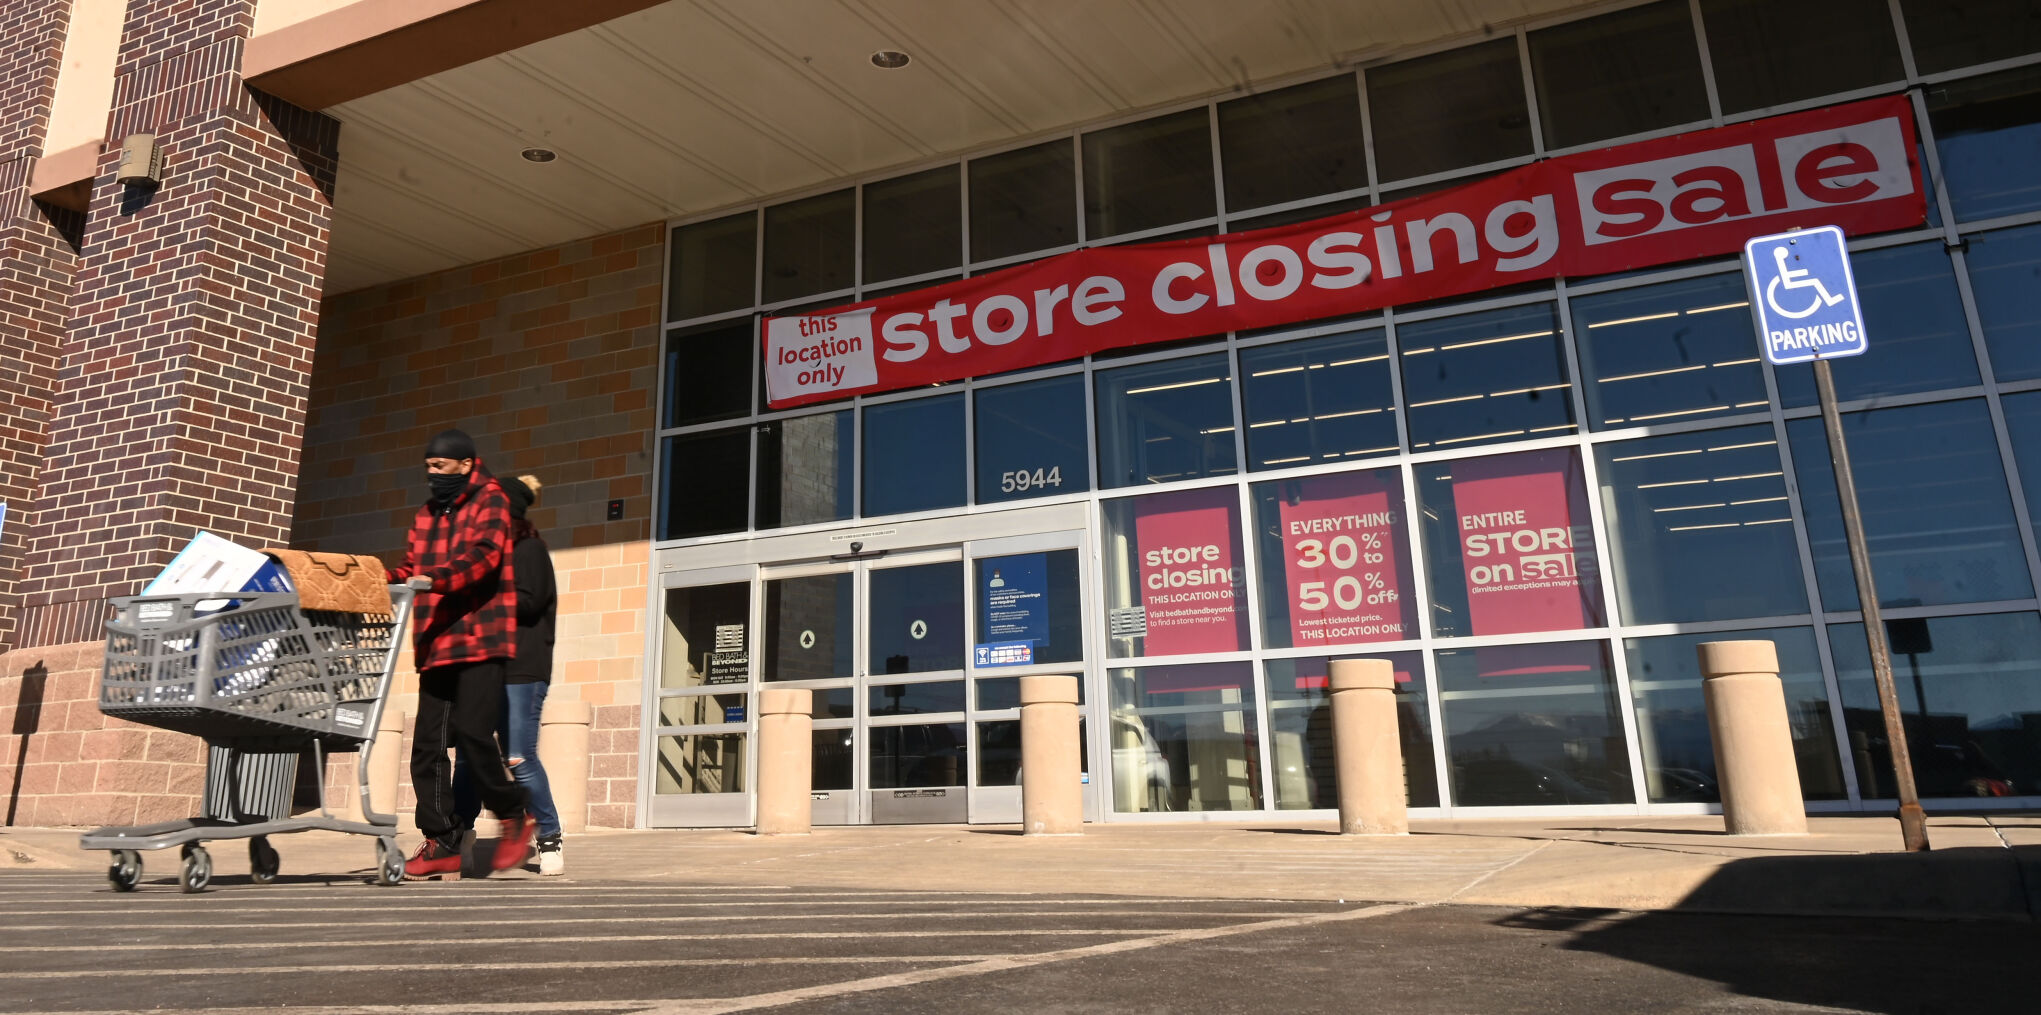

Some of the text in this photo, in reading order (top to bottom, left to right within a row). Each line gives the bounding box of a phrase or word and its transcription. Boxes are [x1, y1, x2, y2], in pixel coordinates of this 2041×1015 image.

[881, 142, 1881, 363] store closing sale
[799, 316, 838, 337] this
[1770, 320, 1858, 352] PARKING
[778, 336, 862, 365] location
[797, 363, 846, 387] only
[1001, 465, 1062, 493] 5944
[1290, 511, 1398, 535] EVERYTHING
[1462, 510, 1527, 530] ENTIRE
[1465, 526, 1594, 557] STORE
[1146, 544, 1220, 567] store
[1363, 551, 1384, 565] to
[1147, 563, 1246, 590] closing
[1470, 553, 1597, 585] on sale
[1149, 594, 1169, 605] THIS
[1170, 590, 1220, 604] LOCATION
[1472, 583, 1503, 595] (limited
[1504, 581, 1551, 592] exceptions
[1552, 580, 1571, 588] may
[1150, 610, 1165, 619] Visit
[1150, 619, 1157, 627] to
[1157, 618, 1171, 627] find
[1176, 617, 1195, 625] store
[1195, 616, 1211, 624] near
[1299, 614, 1383, 627] Lowest ticketed price.
[1300, 623, 1409, 639] THIS LOCATION ONLY
